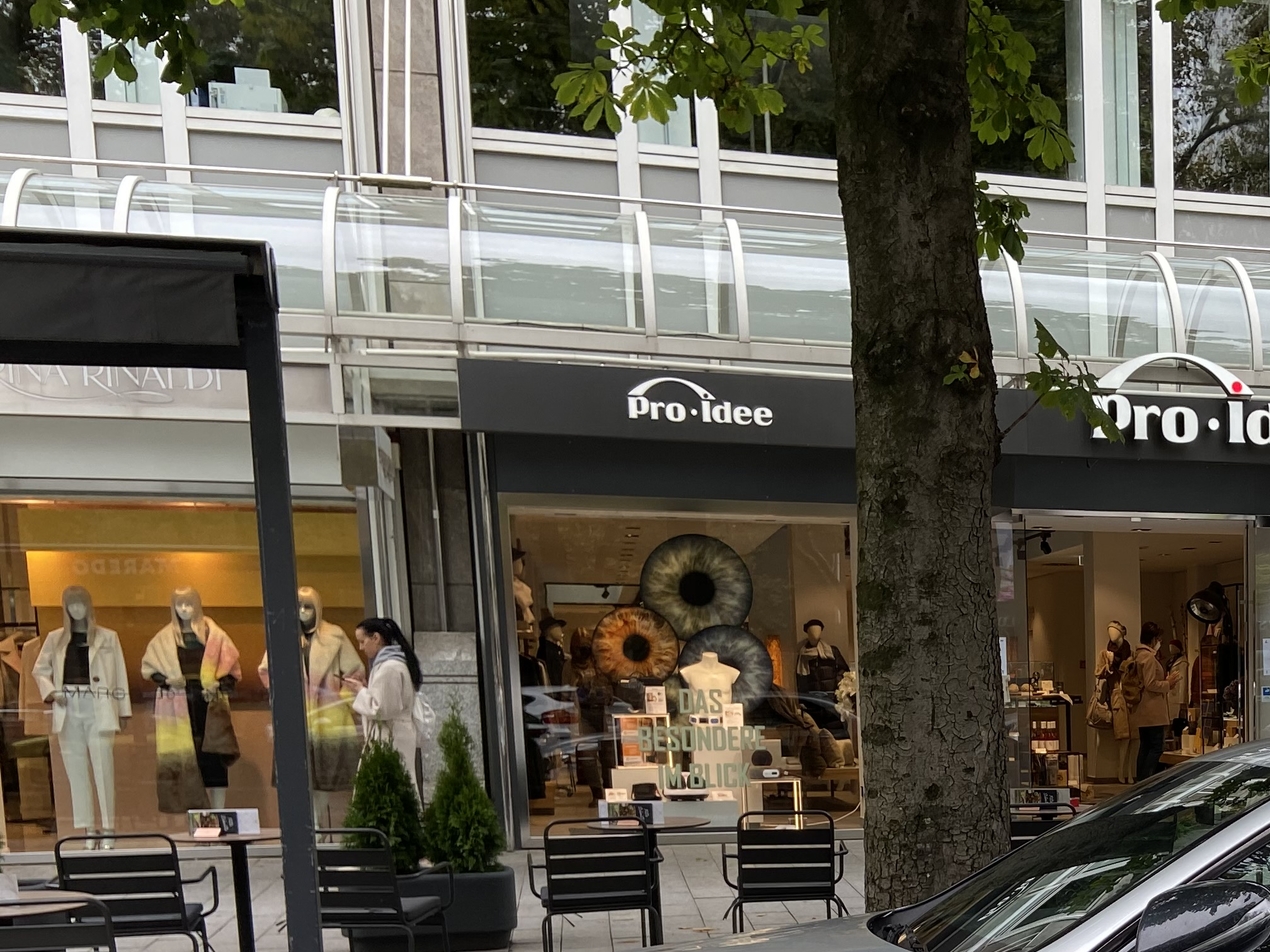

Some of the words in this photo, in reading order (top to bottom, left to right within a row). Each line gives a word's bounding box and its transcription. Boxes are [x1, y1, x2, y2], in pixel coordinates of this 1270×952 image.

[678, 688, 723, 714] DAS
[637, 725, 767, 752] BESONDERE
[658, 764, 683, 789] IM
[689, 763, 751, 789] BLICK
